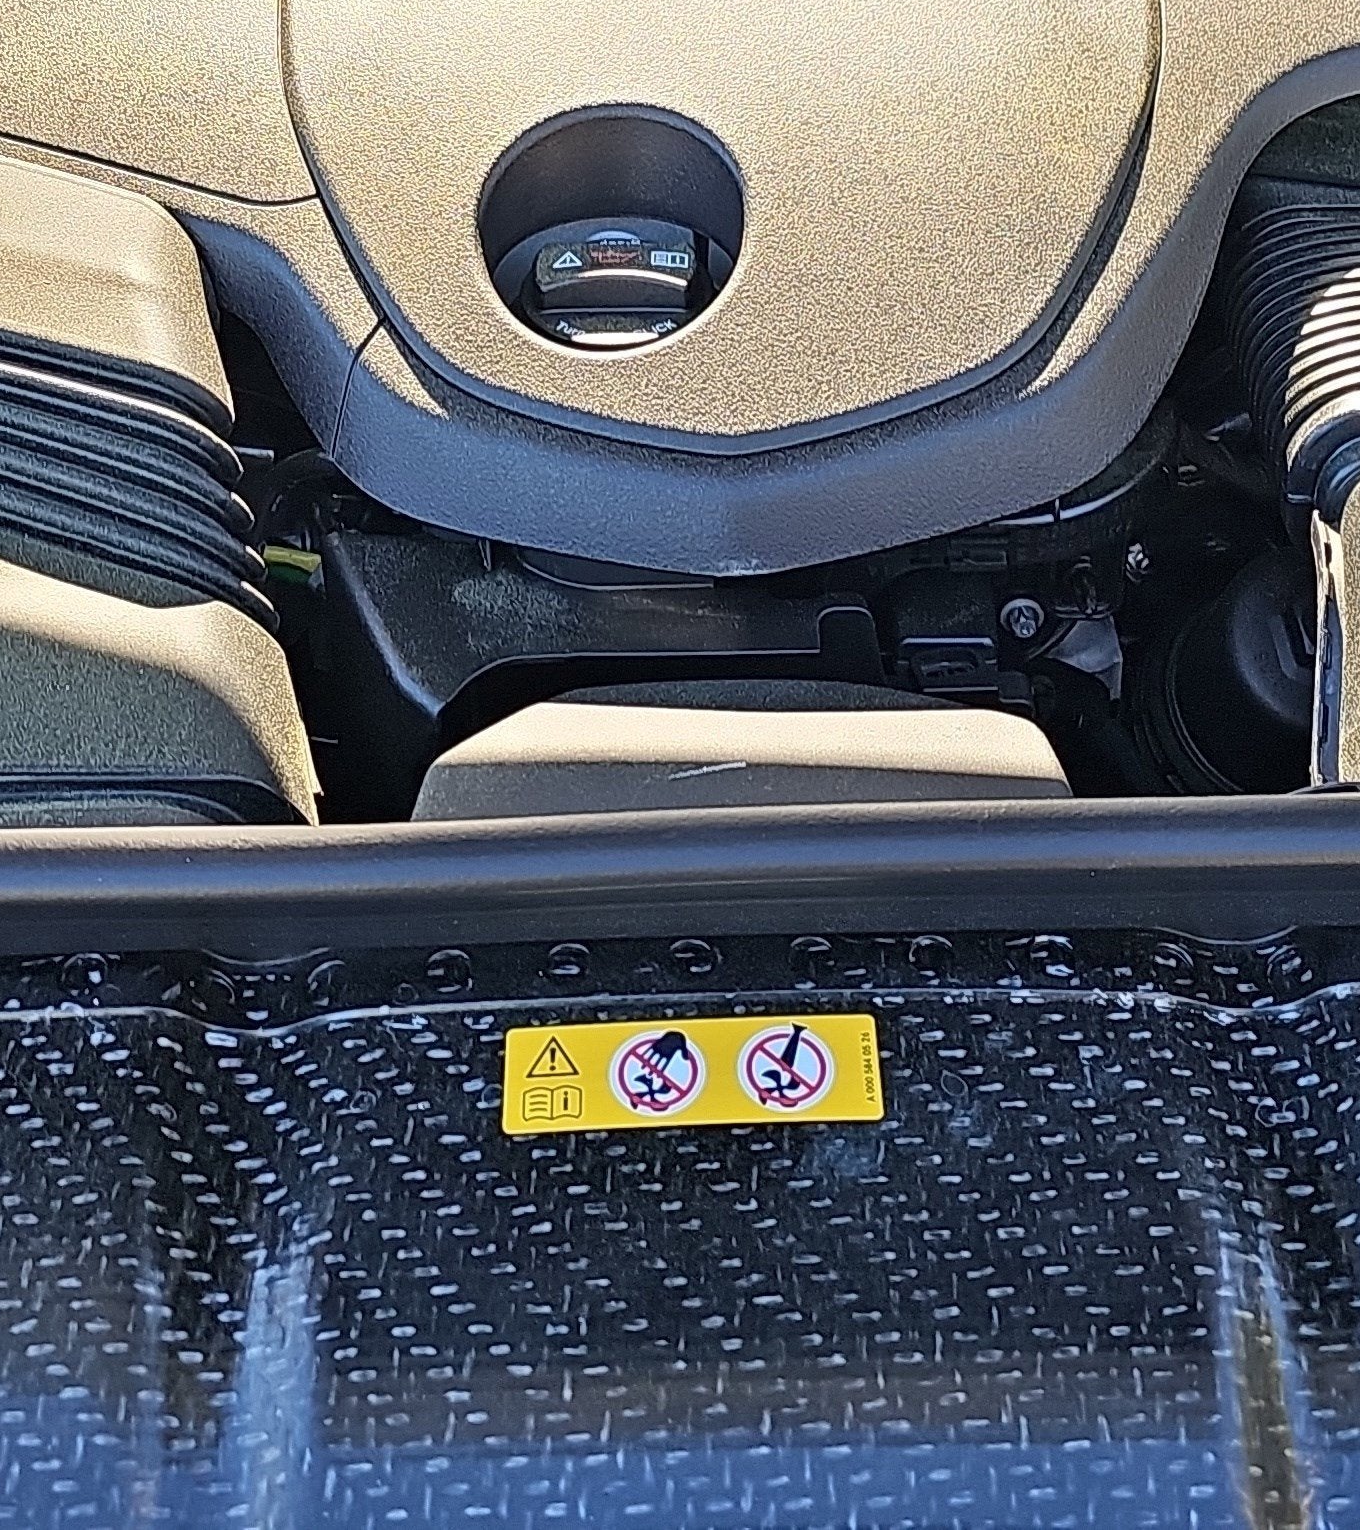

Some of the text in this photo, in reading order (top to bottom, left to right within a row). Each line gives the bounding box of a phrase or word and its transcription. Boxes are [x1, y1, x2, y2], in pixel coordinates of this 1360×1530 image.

[860, 1031, 877, 1103] A 000 584 05 26
